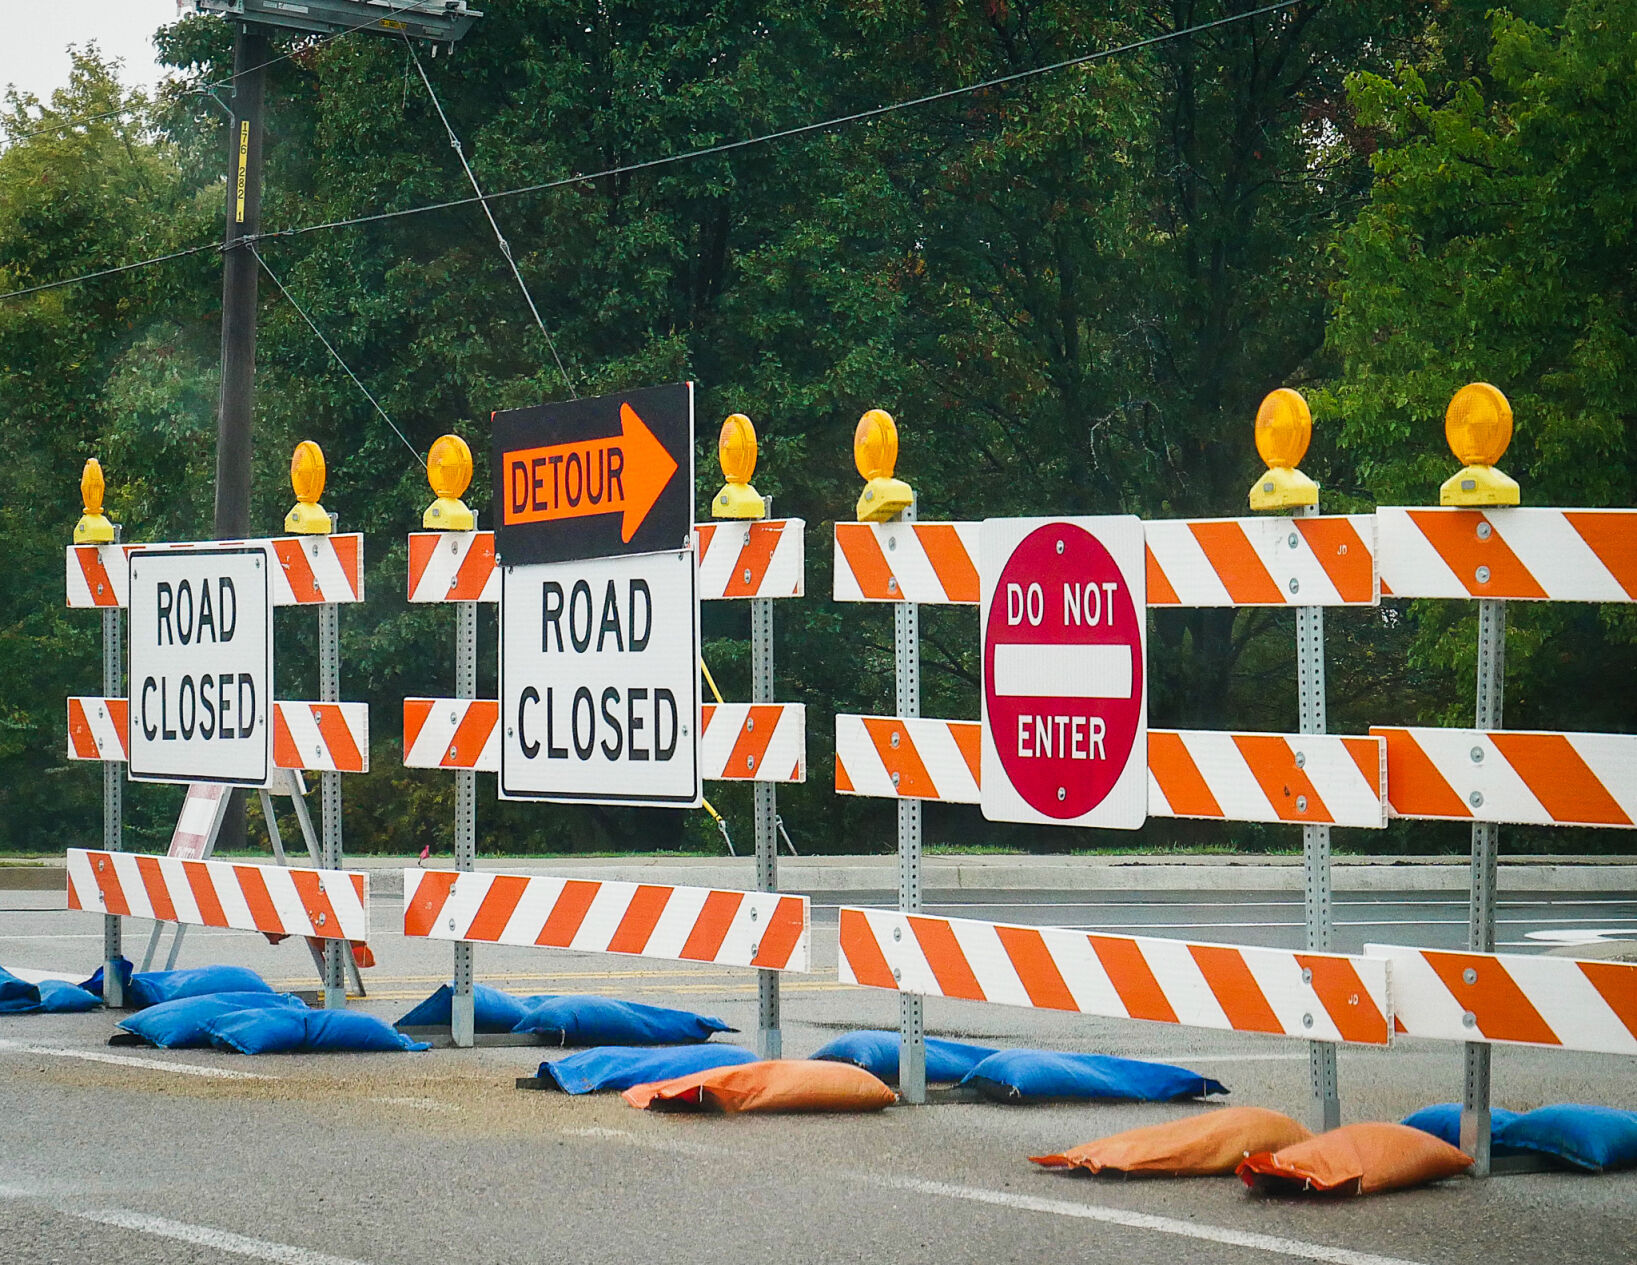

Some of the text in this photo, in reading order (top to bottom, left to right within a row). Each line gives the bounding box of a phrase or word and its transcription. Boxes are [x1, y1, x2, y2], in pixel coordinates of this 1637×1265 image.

[237, 167, 245, 200] 282
[511, 447, 625, 515] DETOUR
[157, 576, 237, 646] ROAD
[541, 578, 652, 653] ROAD
[1006, 582, 1118, 627] DO NOT
[141, 673, 256, 742] CLOSED
[518, 685, 678, 762] CLOSED
[1018, 715, 1106, 760] ENTER
